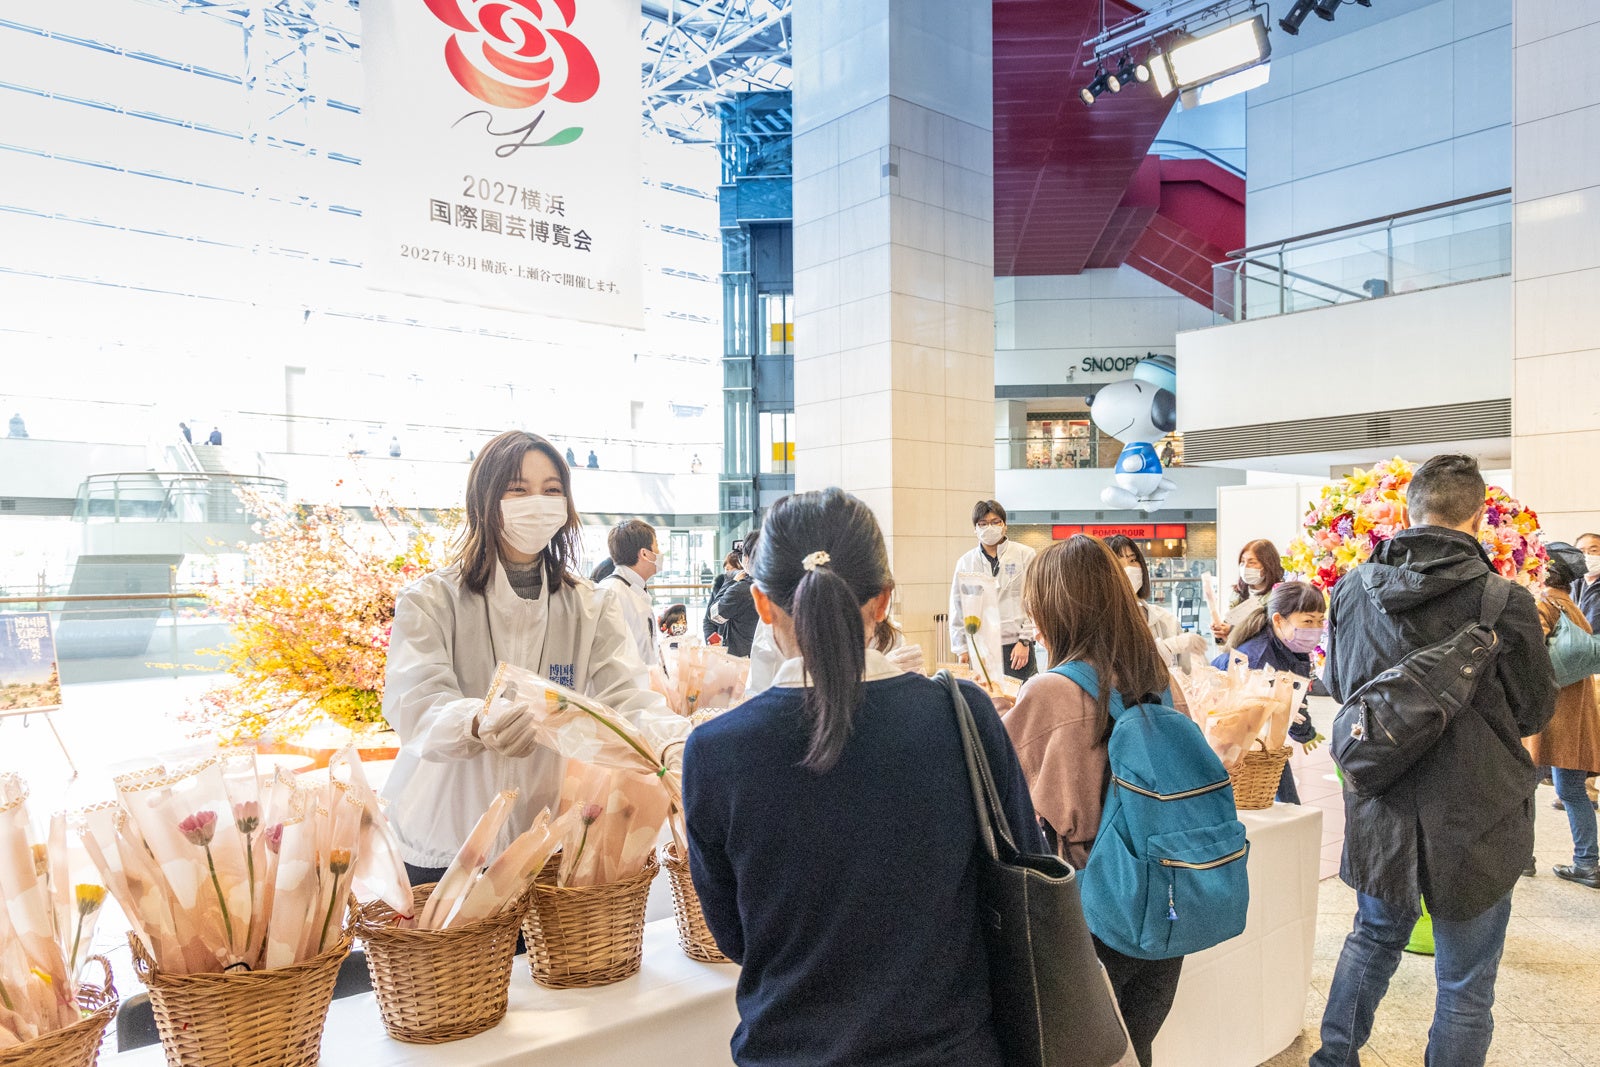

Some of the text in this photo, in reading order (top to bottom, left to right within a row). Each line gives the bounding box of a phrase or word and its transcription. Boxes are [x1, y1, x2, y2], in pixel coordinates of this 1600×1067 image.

[463, 174, 565, 218] 2027横浜
[429, 198, 593, 252] 国際園芸博覧会
